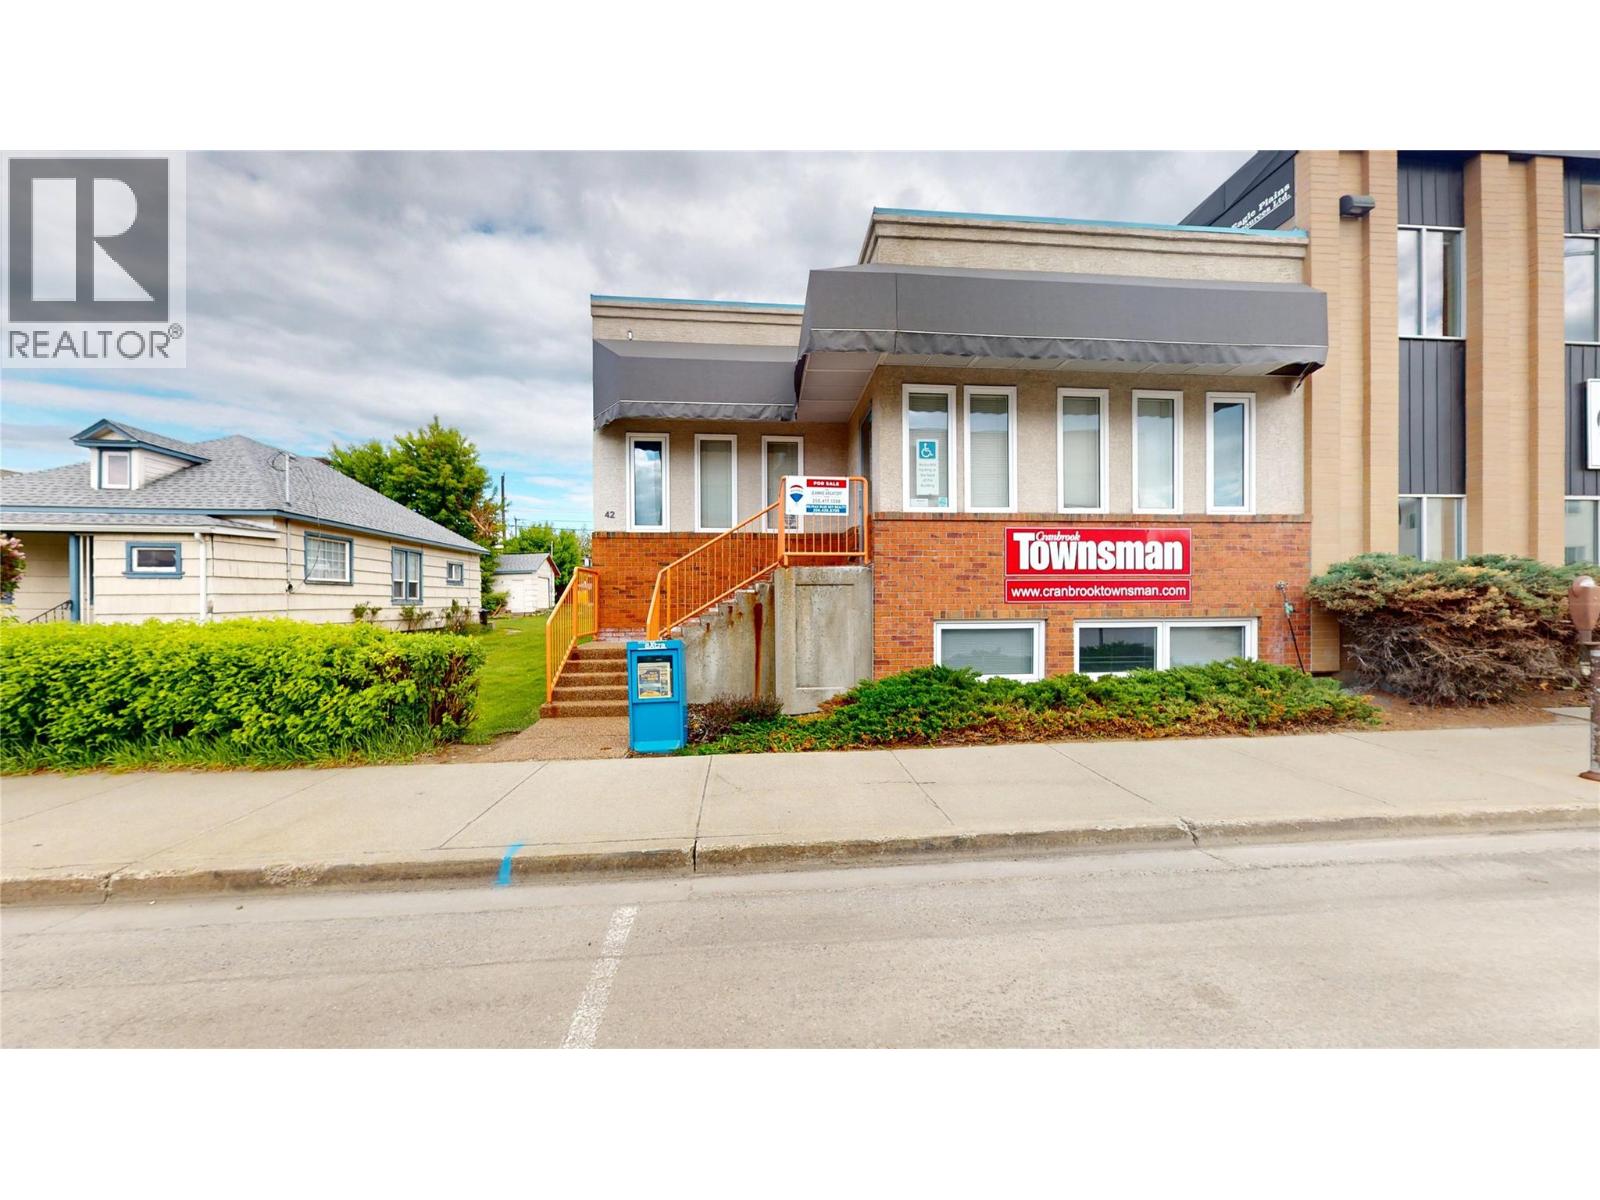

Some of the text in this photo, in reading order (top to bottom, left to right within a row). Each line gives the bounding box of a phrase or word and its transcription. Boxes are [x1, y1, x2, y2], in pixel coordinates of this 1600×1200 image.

[1258, 183, 1290, 211] Plains
[1035, 531, 1081, 542] Cranbrook
[1013, 532, 1183, 571] Townsman
[1011, 585, 1187, 598] www.cranbrooktownsman.com
